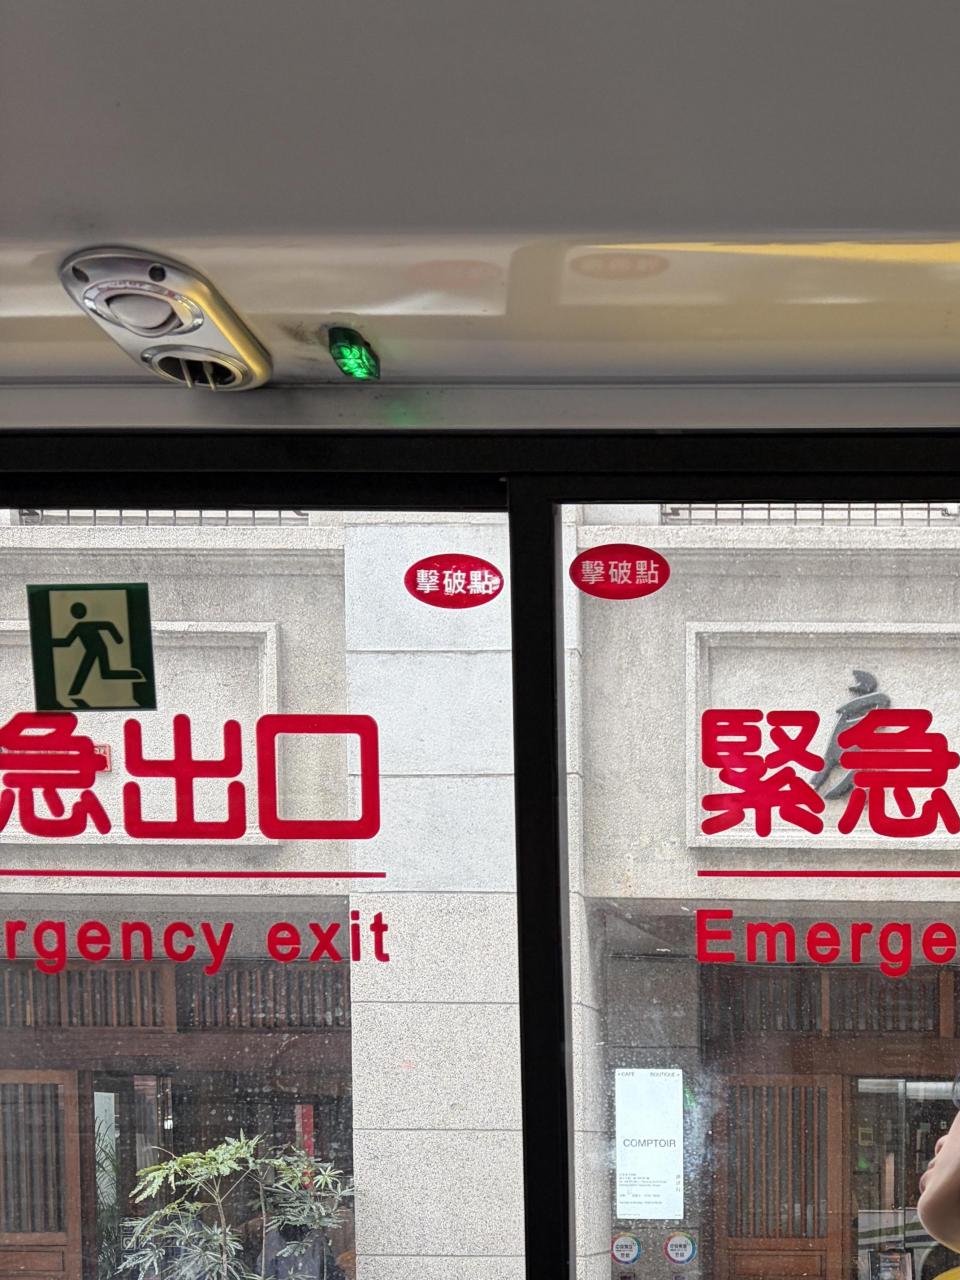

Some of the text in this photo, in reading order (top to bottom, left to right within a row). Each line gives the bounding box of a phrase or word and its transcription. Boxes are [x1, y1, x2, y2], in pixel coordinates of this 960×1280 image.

[416, 569, 494, 595] 擊破點
[581, 560, 660, 585] 擊破點
[0, 712, 380, 840] 急出口
[267, 910, 390, 962] exit
[623, 1138, 676, 1148] COMPTOIR
